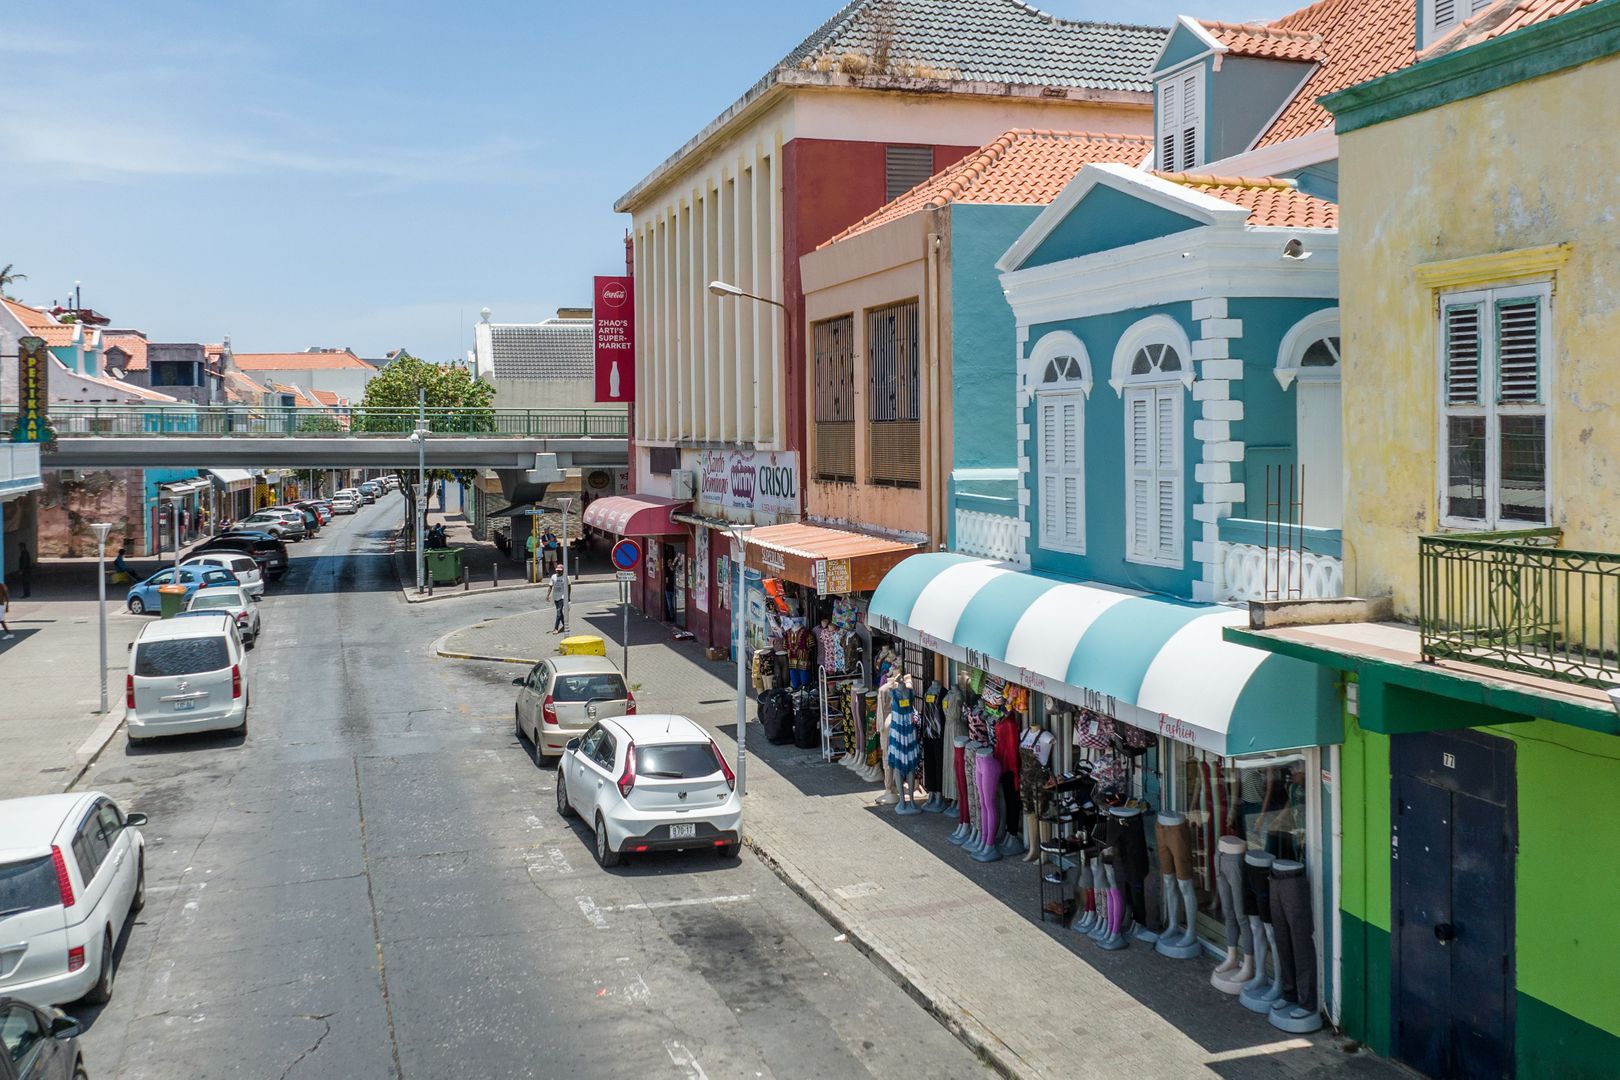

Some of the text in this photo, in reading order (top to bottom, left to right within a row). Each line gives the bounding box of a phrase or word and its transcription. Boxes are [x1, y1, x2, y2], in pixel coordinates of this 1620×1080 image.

[27, 357, 37, 440] PELIKAAN
[706, 450, 725, 475] Santo
[701, 469, 728, 503] Domingo
[759, 465, 796, 498] CRISOL
[982, 653, 990, 672] IN
[1019, 666, 1046, 690] Fashion
[1107, 695, 1117, 718] IN
[1158, 712, 1197, 742] Fashion
[1445, 754, 1454, 766] 77
